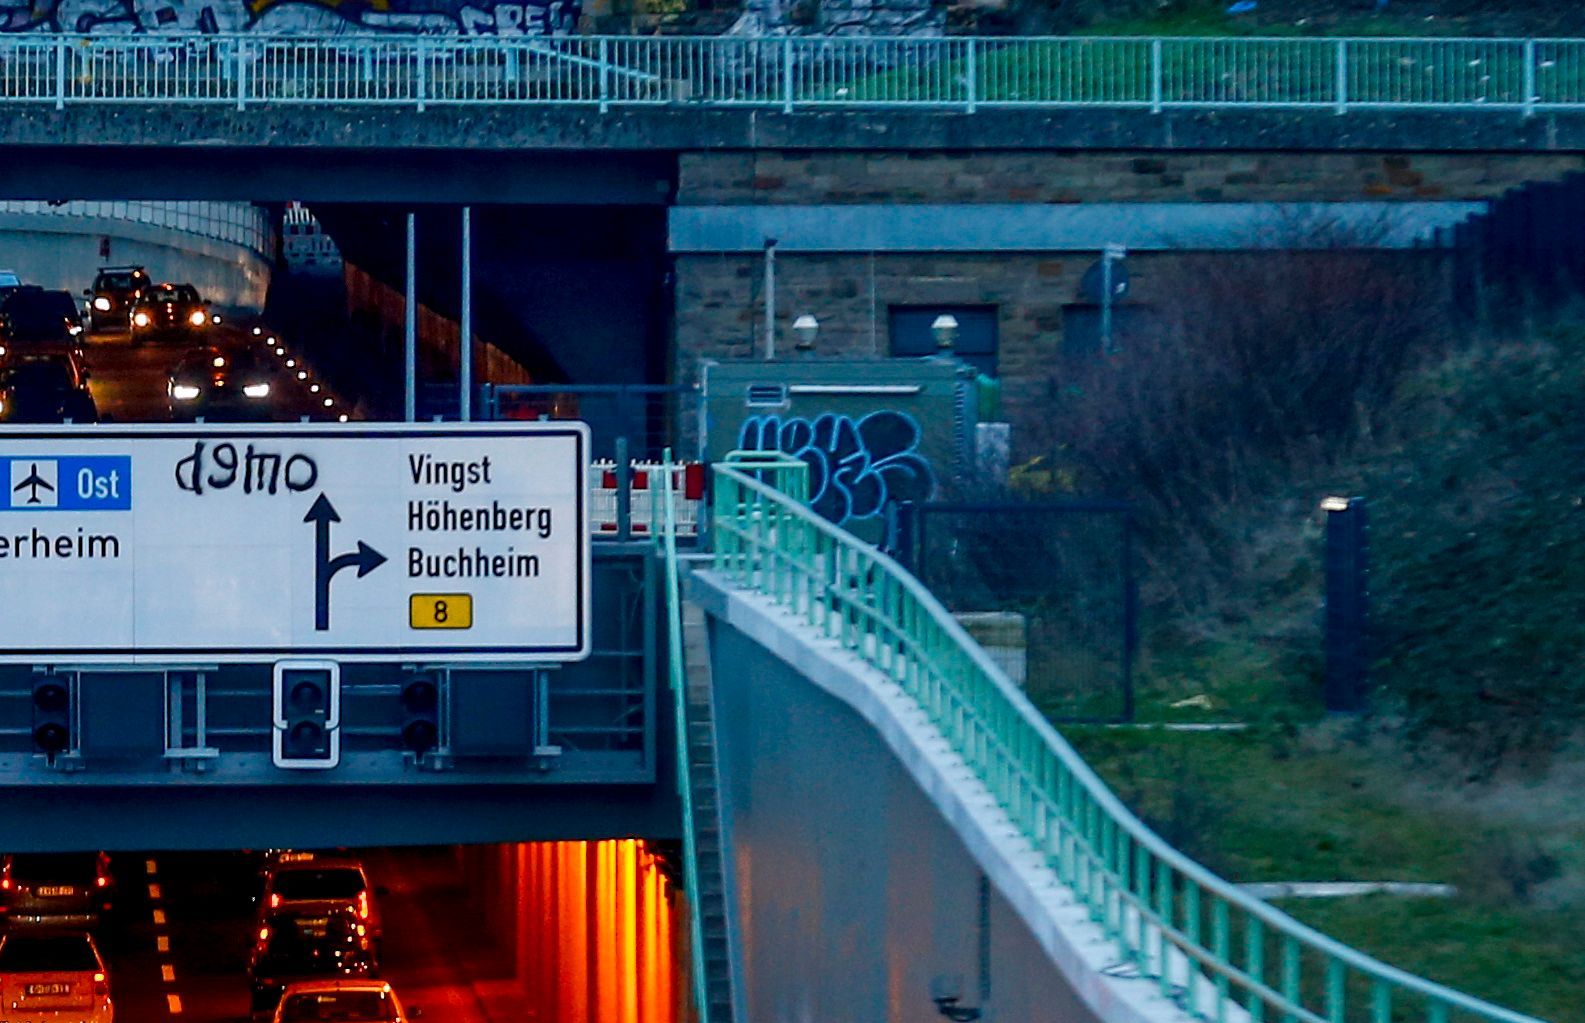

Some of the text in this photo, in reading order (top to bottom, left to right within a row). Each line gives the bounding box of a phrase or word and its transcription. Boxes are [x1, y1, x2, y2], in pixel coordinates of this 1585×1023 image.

[77, 467, 120, 499] Ost
[408, 453, 492, 492] Vingst
[408, 500, 552, 538] Höhenberg
[408, 546, 540, 578] Buchheim
[433, 600, 448, 623] 8
